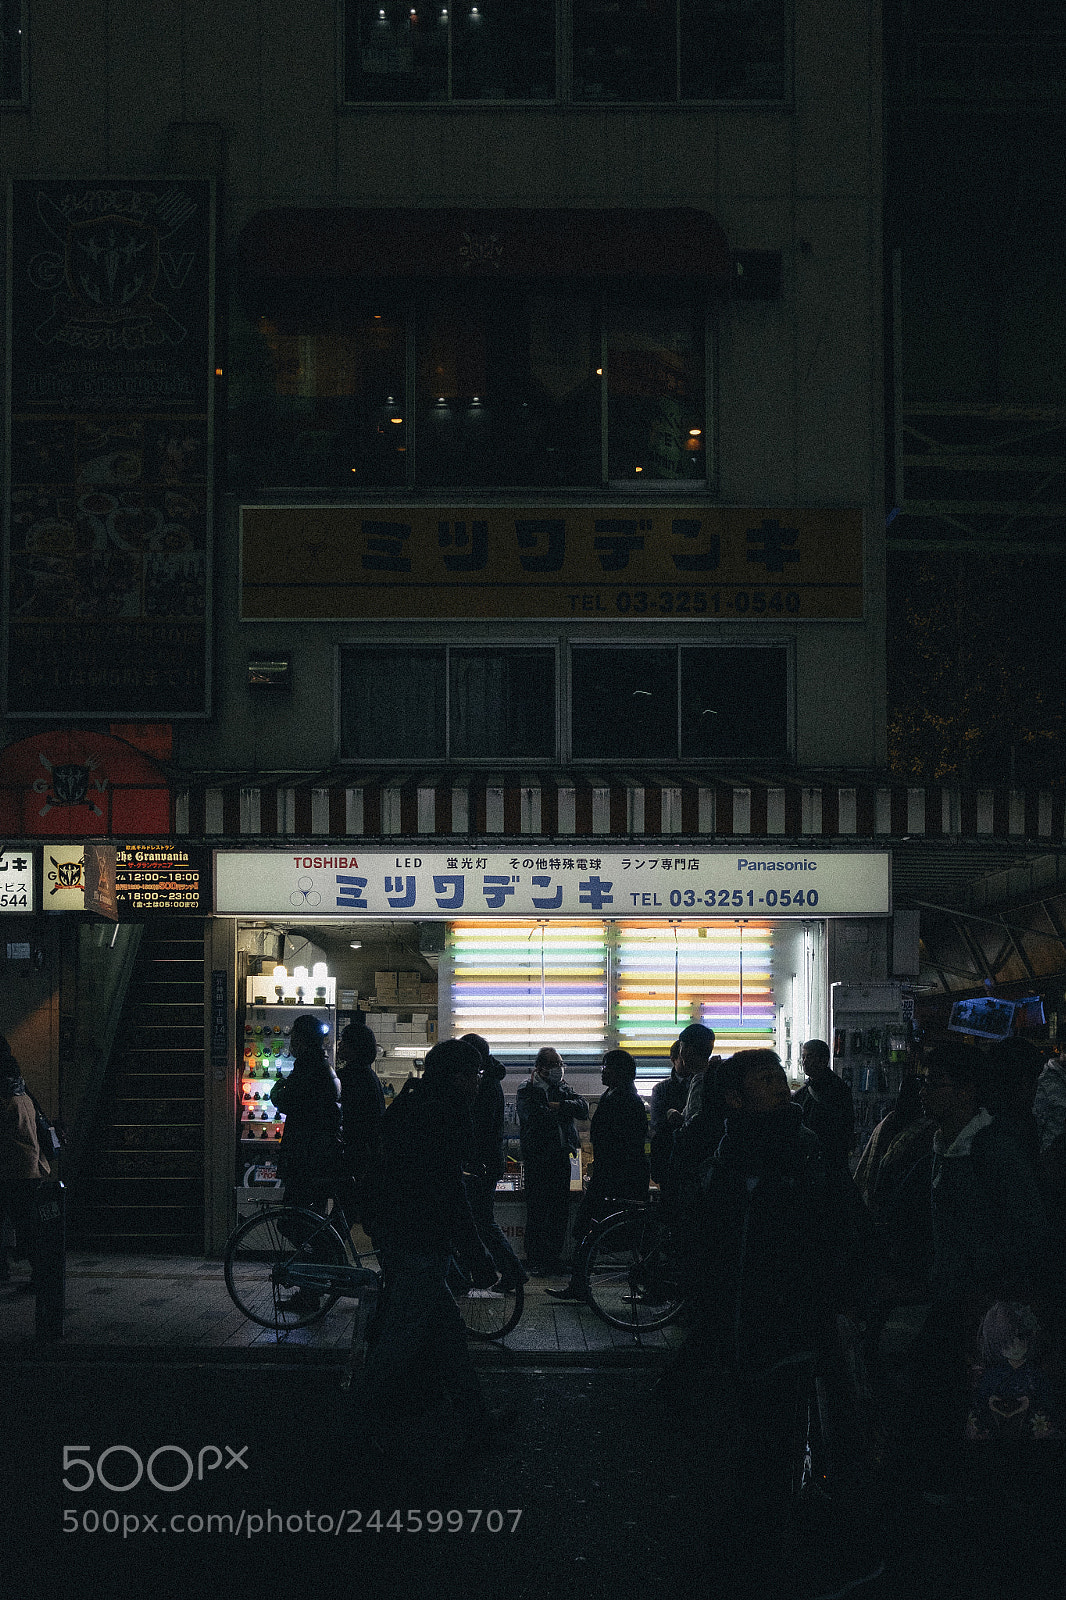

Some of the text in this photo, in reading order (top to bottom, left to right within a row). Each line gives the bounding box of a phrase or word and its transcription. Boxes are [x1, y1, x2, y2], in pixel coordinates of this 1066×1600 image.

[361, 519, 801, 573] ミツワデンキ
[567, 591, 801, 613] TEL 03-3251-0540
[33, 778, 109, 794] G V
[294, 857, 359, 869] TOSHIBA
[395, 857, 423, 869] LED
[509, 857, 603, 871] その他特殊電球
[620, 857, 701, 871] ランプ専門店
[737, 858, 818, 872] Panasonic
[47, 871, 58, 881] G
[335, 874, 820, 910] ミツワデンキ TEL 03-3251-0540
